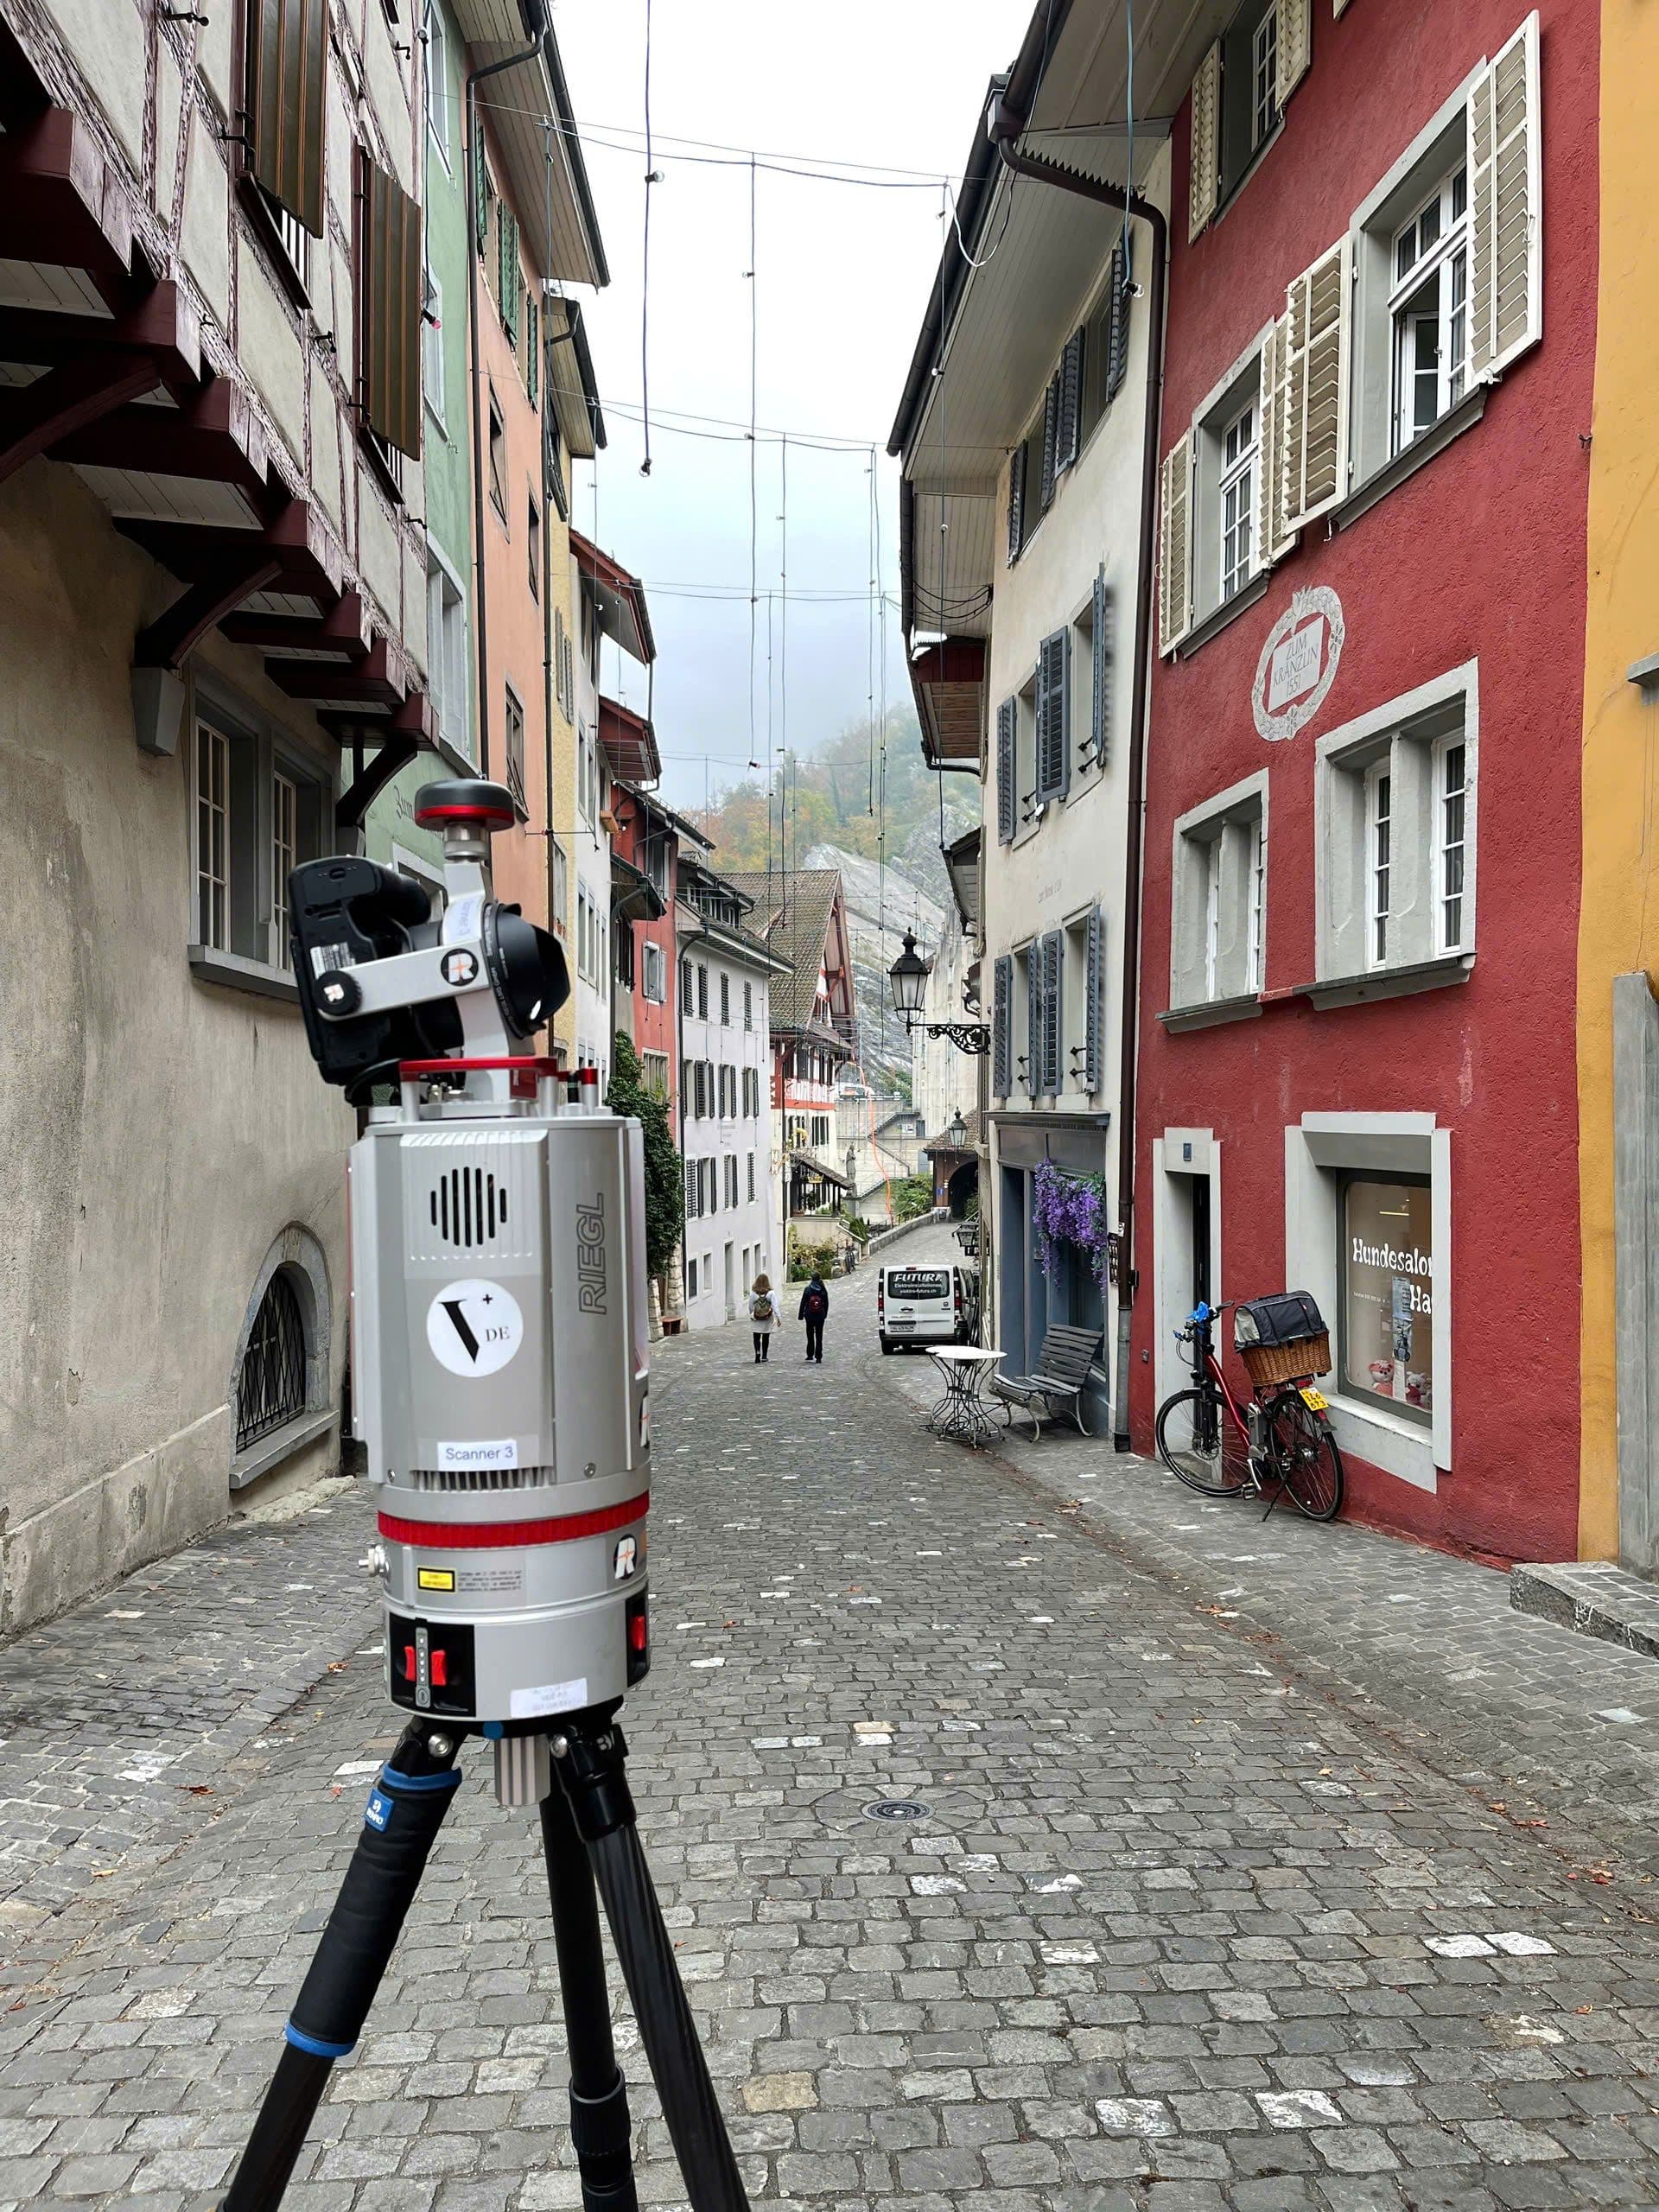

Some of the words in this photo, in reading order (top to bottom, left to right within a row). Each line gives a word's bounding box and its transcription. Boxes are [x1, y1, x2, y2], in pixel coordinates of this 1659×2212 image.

[1286, 632, 1307, 661] ZUM
[576, 1192, 607, 1314] RIEGL
[893, 1273, 943, 1282] FUTURA
[486, 1326, 511, 1342] DE
[446, 1447, 501, 1460] Scanner
[505, 1446, 514, 1459] 3
